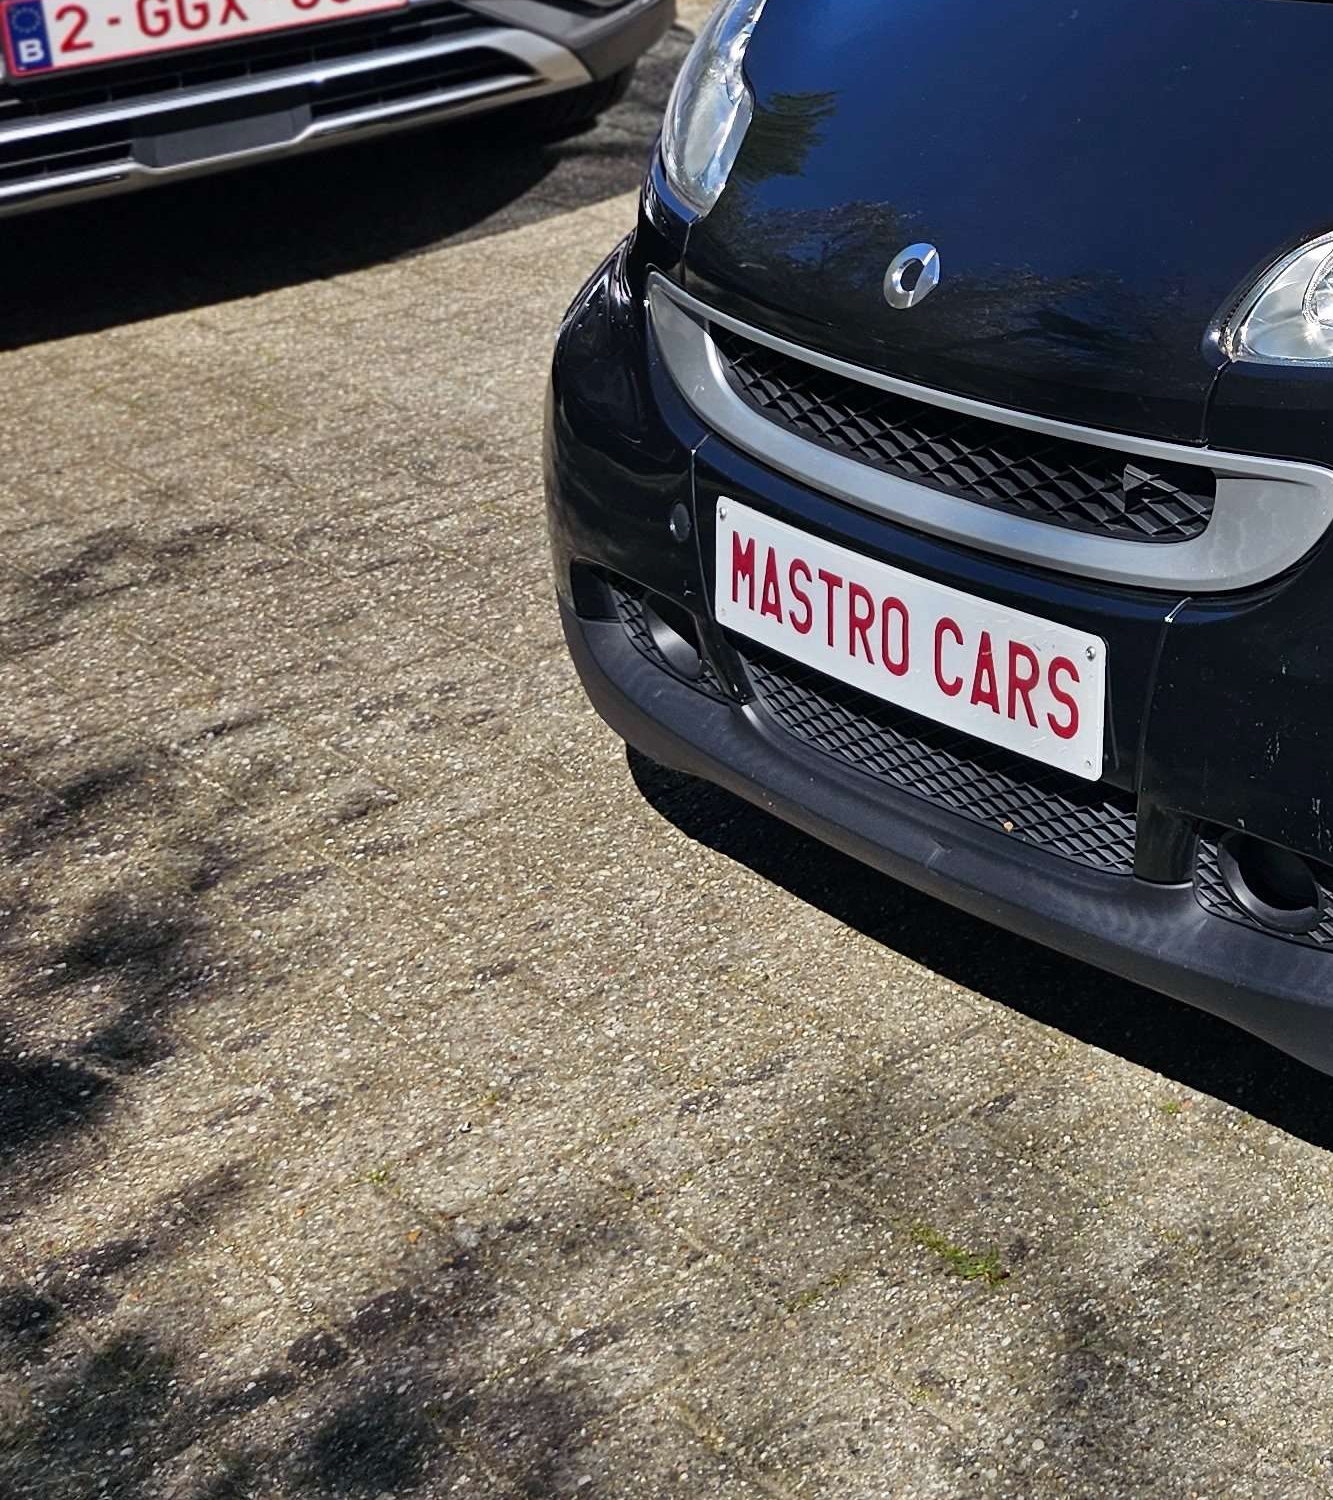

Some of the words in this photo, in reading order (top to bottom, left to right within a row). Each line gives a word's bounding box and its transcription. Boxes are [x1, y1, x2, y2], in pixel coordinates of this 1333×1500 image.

[18, 38, 45, 64] B
[732, 530, 909, 677] MASTRO
[934, 616, 1081, 740] CARS
